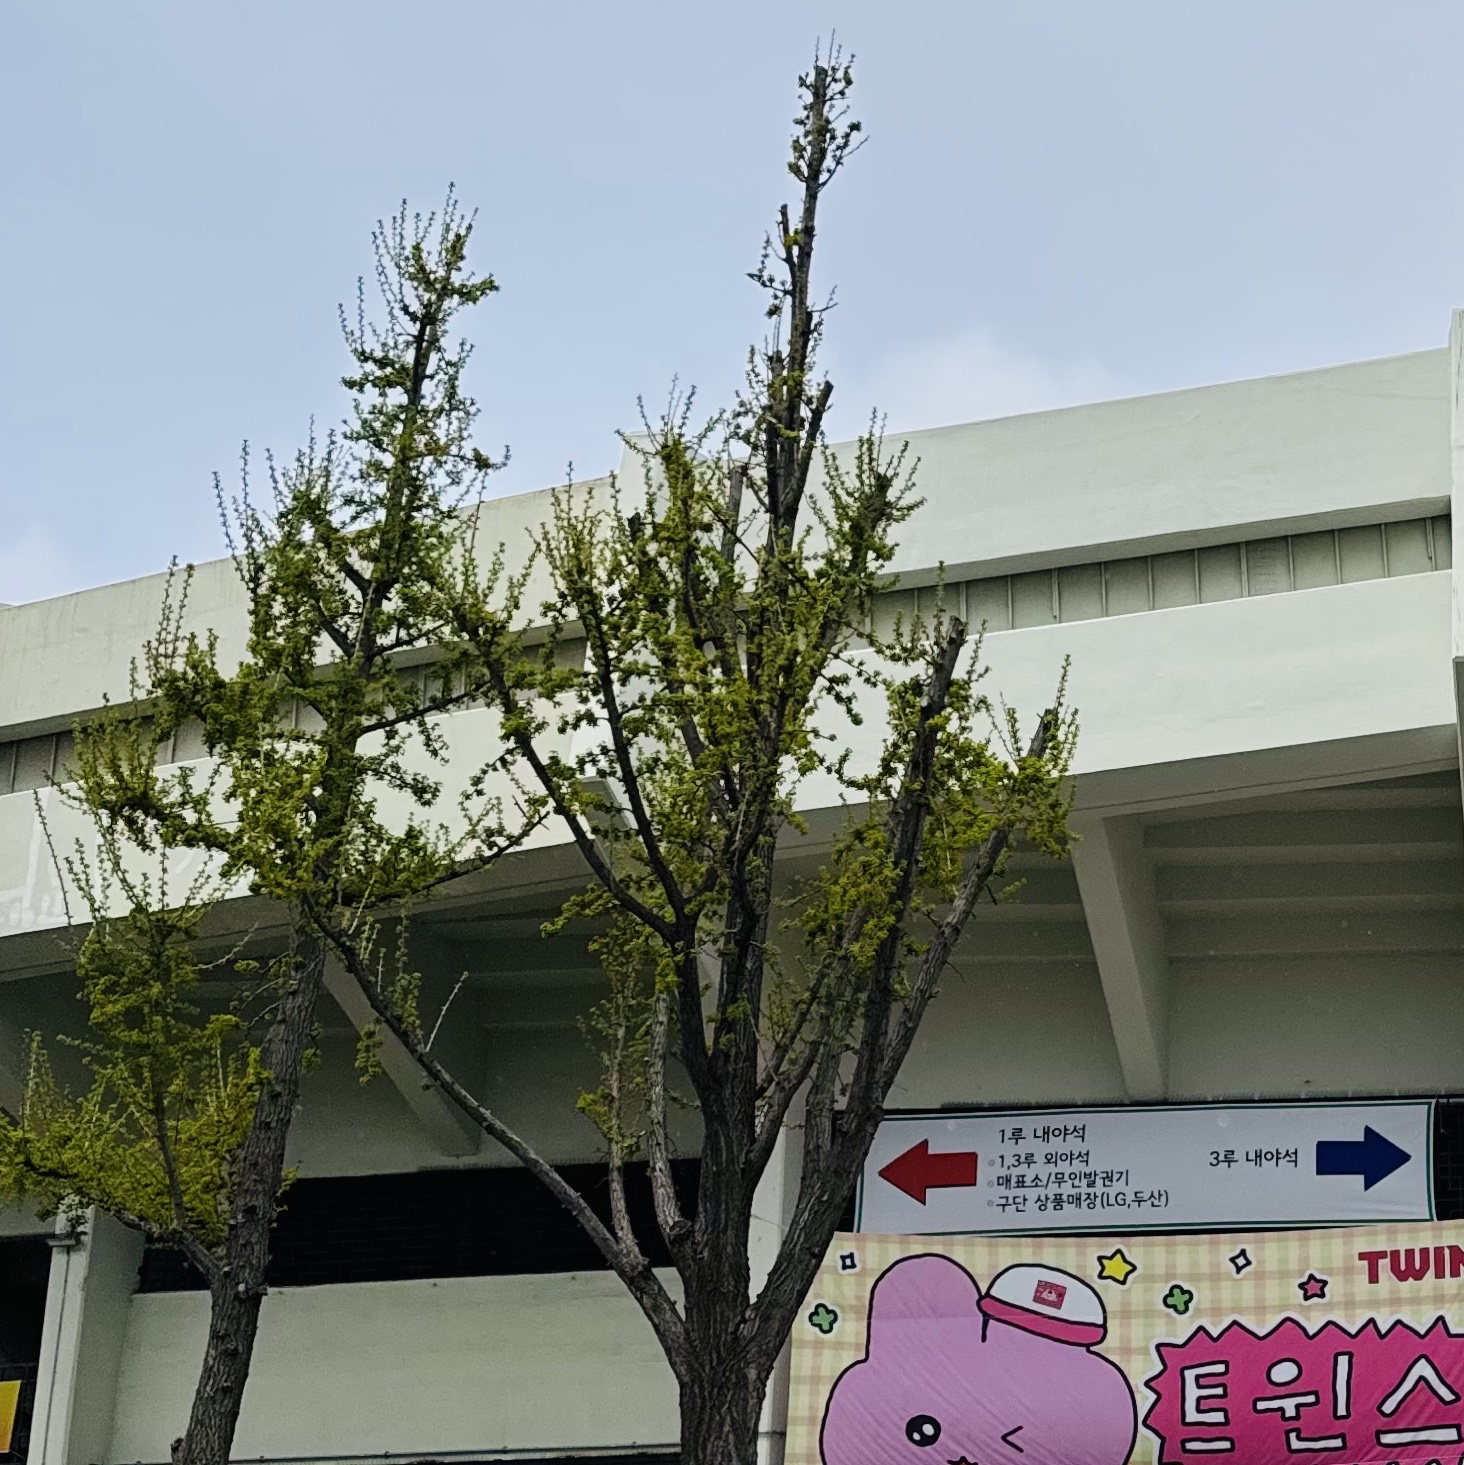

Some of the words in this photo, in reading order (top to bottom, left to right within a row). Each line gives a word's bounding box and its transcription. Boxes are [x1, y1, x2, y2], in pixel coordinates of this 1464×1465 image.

[998, 1127, 1026, 1145] 1루
[1033, 1124, 1086, 1143] 내야석
[998, 1152, 1036, 1169] 1,3루
[1043, 1150, 1089, 1167] 외야석
[1208, 1150, 1239, 1168] 3루
[1245, 1147, 1298, 1168] 내야석
[996, 1169, 1129, 1189] 매표소/무인발권기
[996, 1194, 1027, 1212] 구단
[1034, 1189, 1169, 1211] 상품매장(LG,두산)
